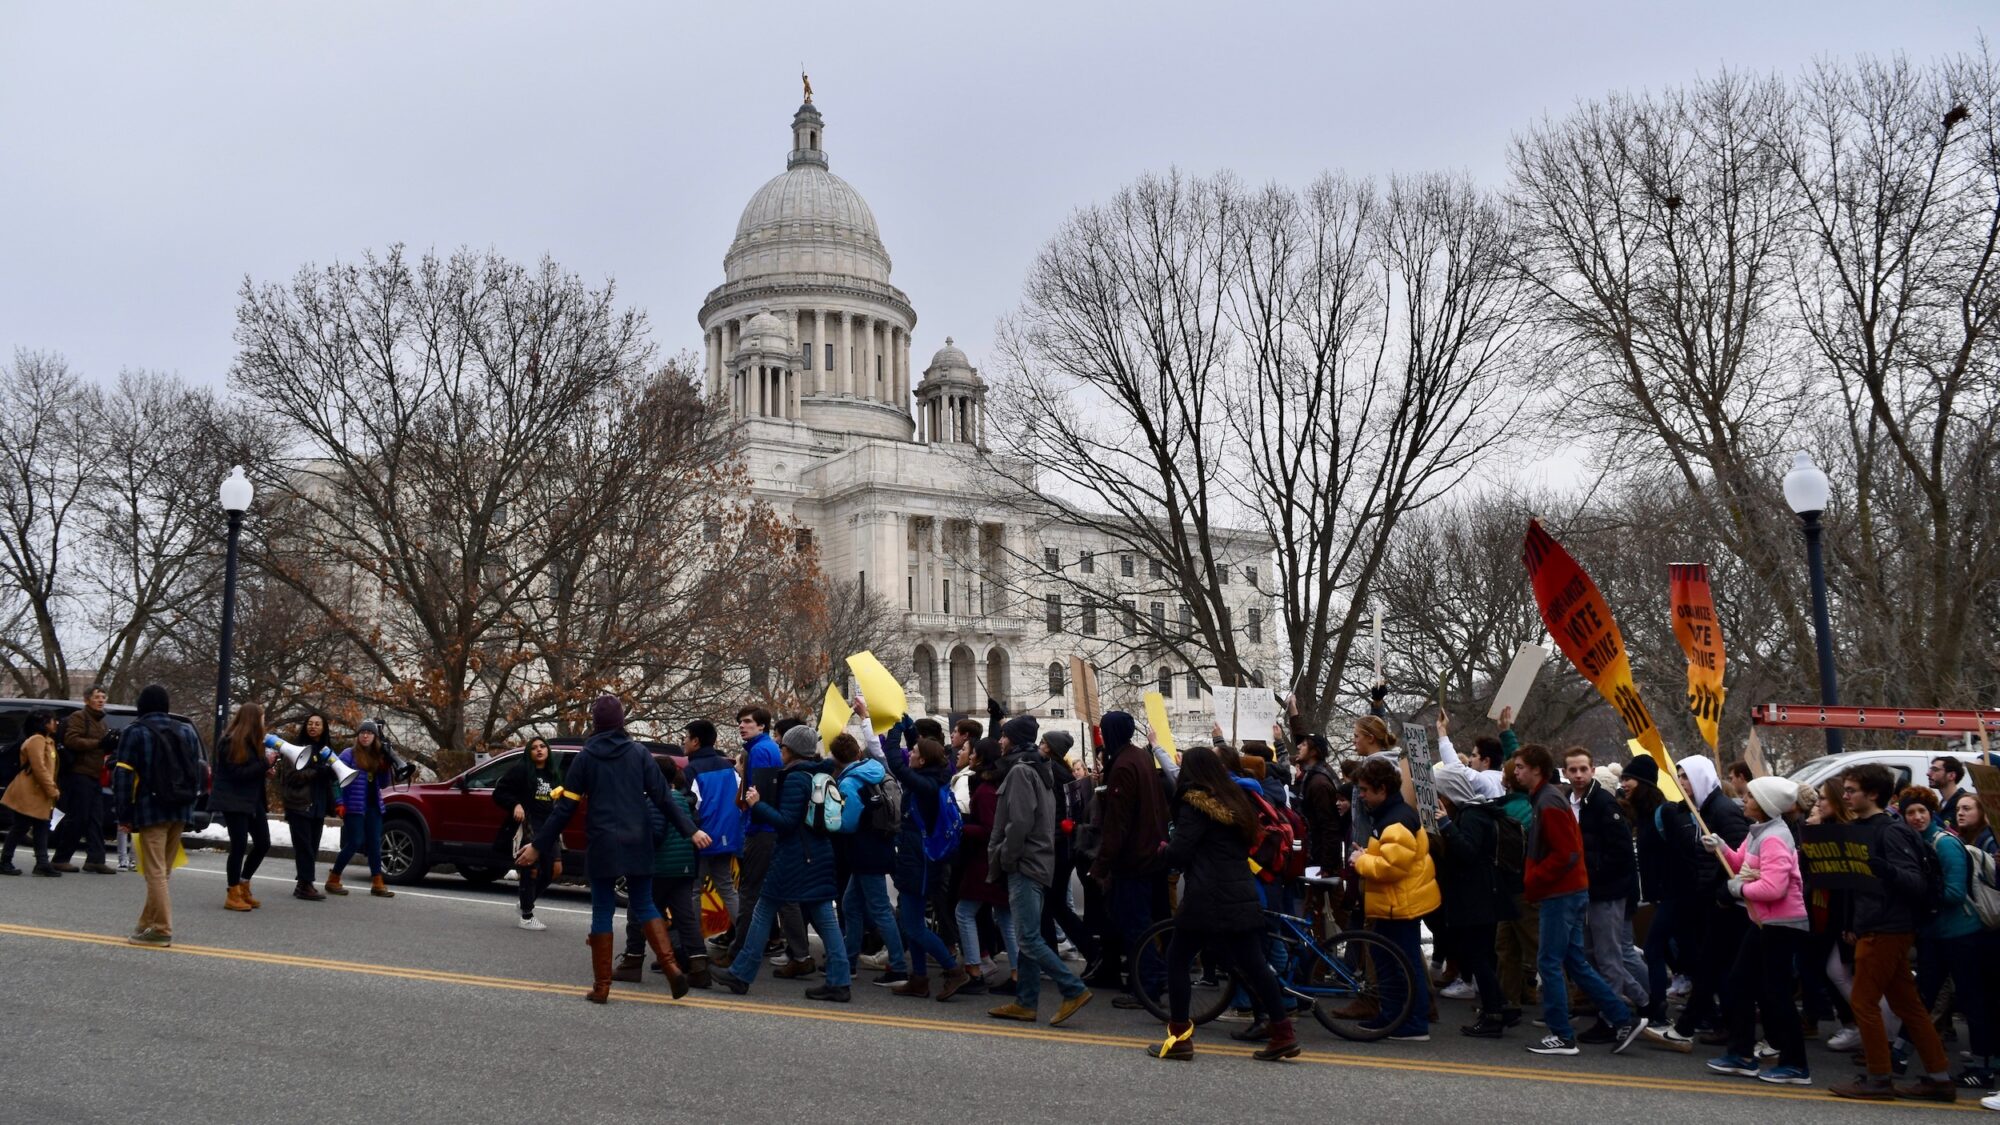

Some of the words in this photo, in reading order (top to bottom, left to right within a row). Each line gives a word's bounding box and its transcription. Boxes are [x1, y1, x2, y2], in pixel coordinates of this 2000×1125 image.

[1564, 601, 1602, 649] VOTE
[1582, 631, 1618, 676] STRIKE
[1801, 841, 1841, 858] GOOD
[1810, 860, 1848, 873] LIVABLE
